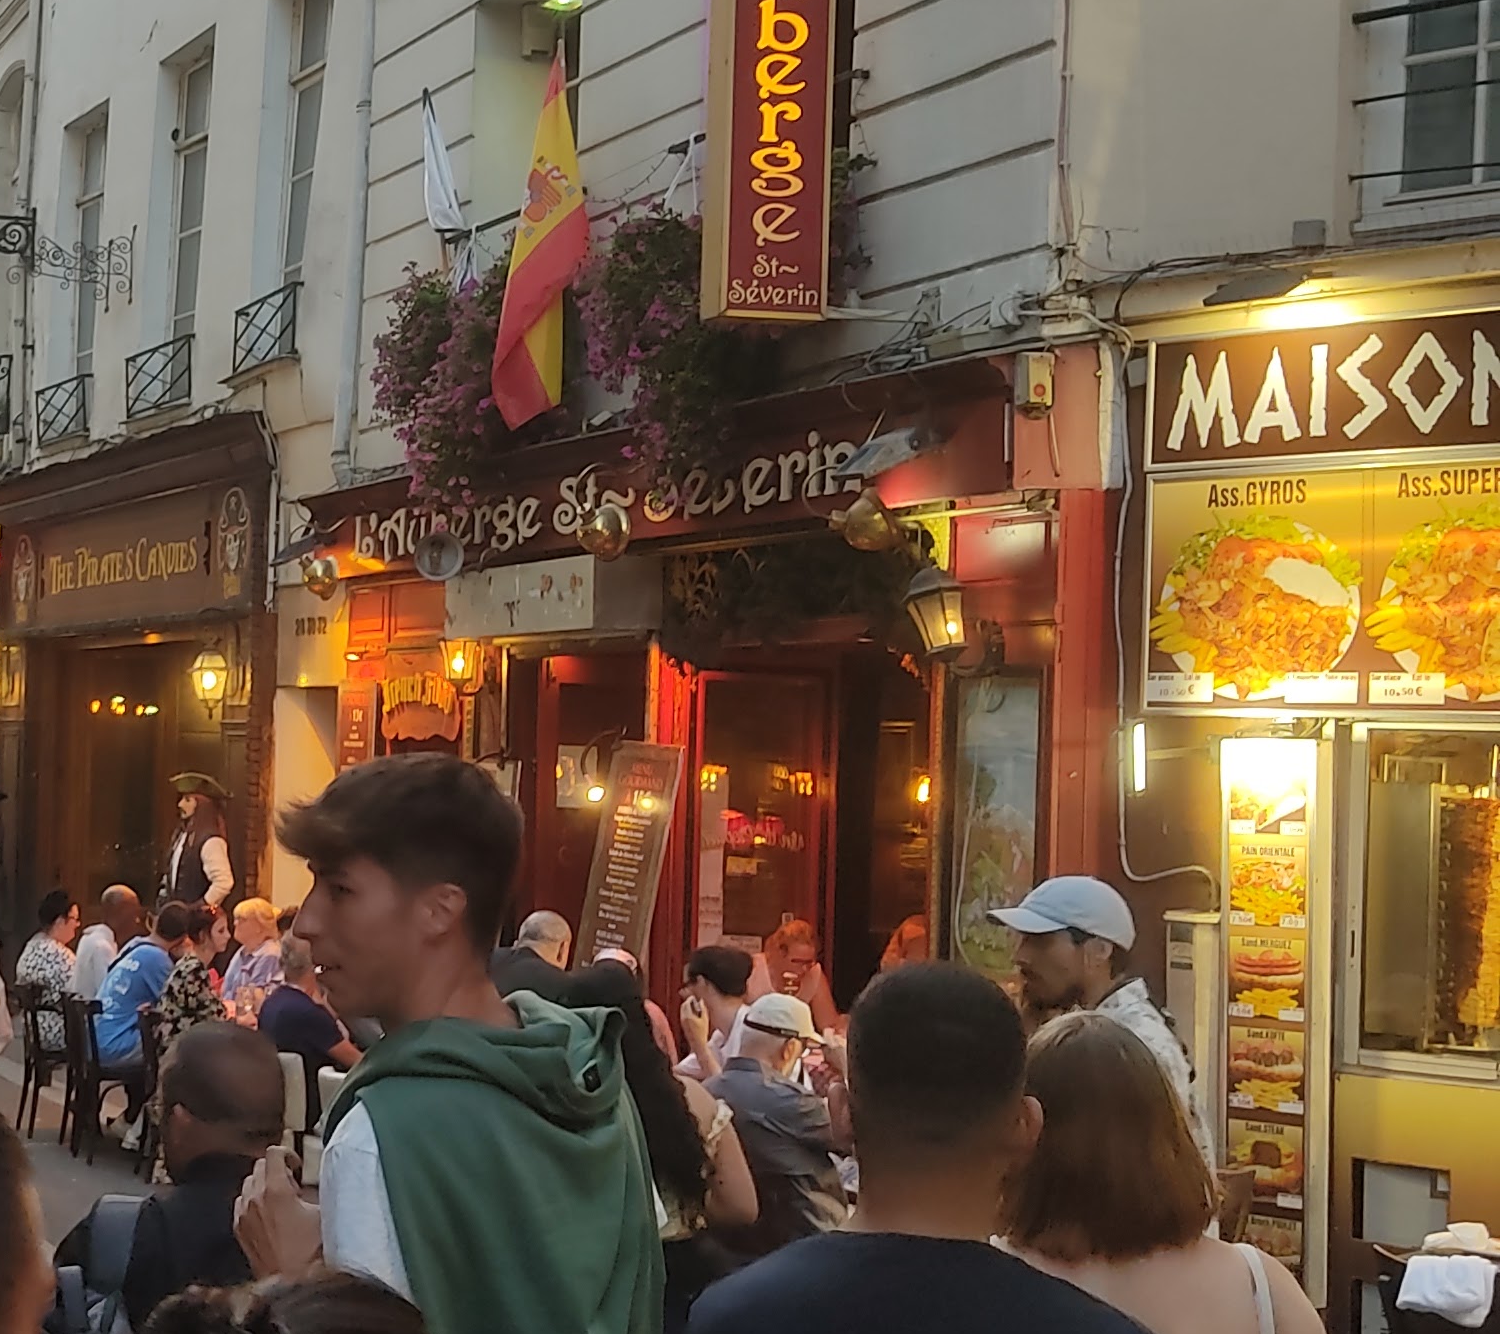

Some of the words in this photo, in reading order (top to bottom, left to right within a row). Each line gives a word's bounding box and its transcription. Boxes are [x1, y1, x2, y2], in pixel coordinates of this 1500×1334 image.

[728, 278, 819, 306] Séverin
[1206, 478, 1308, 509] Ass.GYROS
[50, 555, 75, 595] THE
[135, 536, 198, 582] CANDIES
